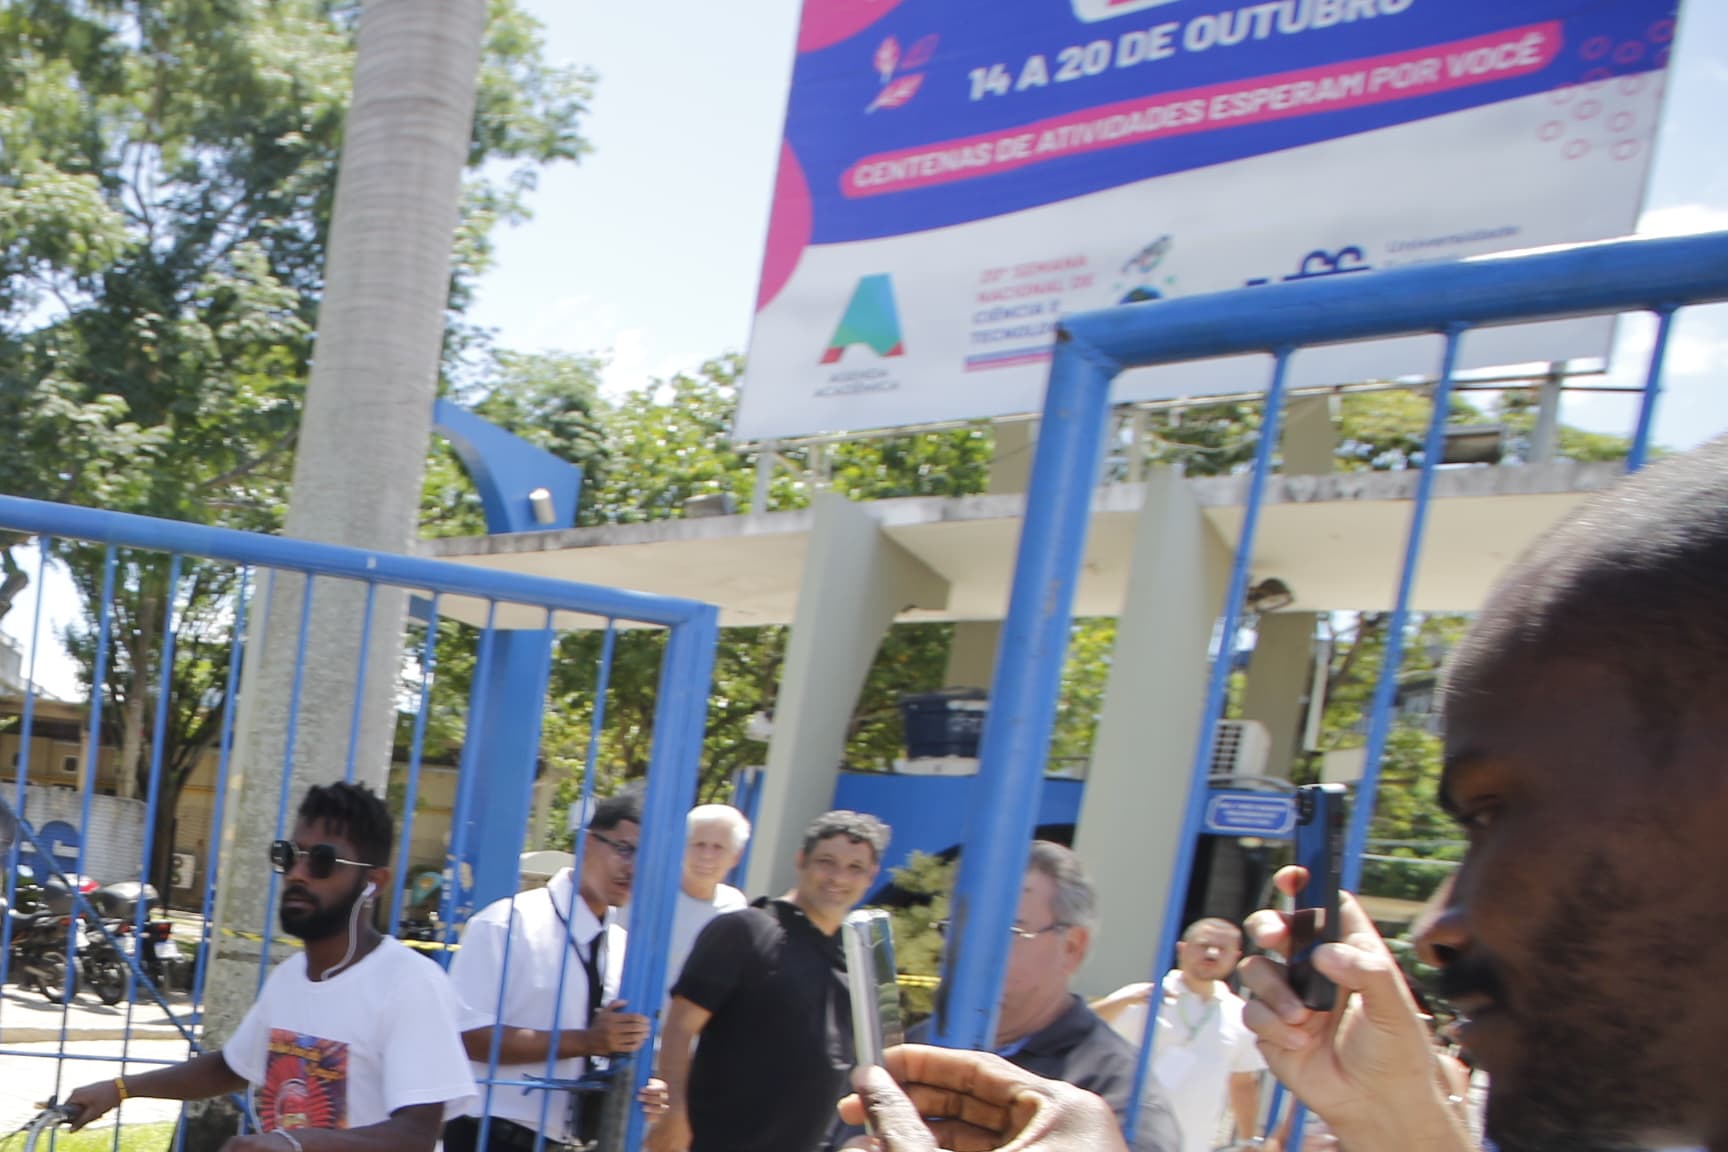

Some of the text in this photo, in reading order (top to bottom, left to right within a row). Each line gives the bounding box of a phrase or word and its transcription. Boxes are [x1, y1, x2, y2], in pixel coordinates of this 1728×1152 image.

[852, 32, 1547, 187] CENTENAS DE ATIVIDADES ESPERAM POR VOCÊ
[967, 63, 1012, 101] 14
[1015, 54, 1049, 91] A
[1053, 39, 1112, 82] 20
[1115, 22, 1180, 69] DE
